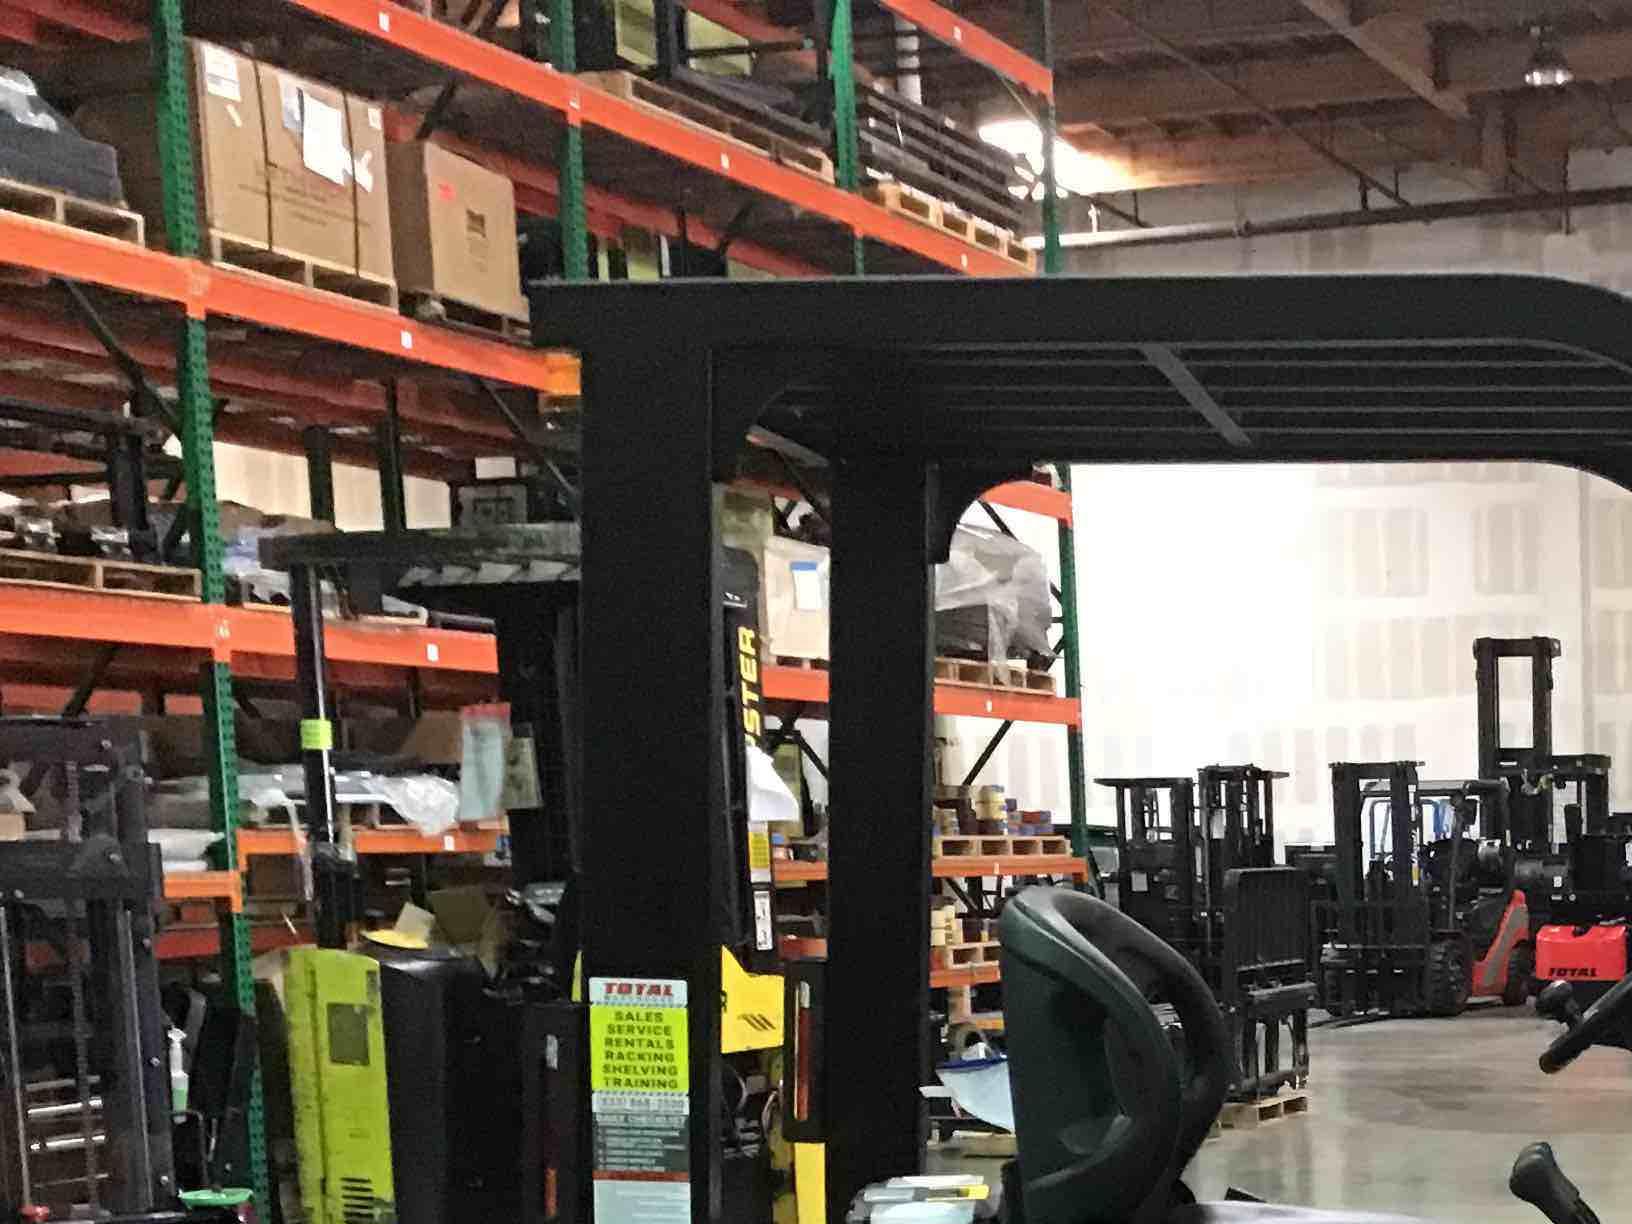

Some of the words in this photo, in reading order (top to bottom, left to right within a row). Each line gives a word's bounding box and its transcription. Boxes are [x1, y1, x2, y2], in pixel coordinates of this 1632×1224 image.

[1548, 967, 1597, 977] TOTAL
[603, 982, 674, 997] TOTAL
[614, 1011, 664, 1023] SALES
[607, 1024, 673, 1036] SERVICE
[604, 1037, 675, 1050] RENTALS
[604, 1050, 675, 1063] RACKING
[602, 1063, 679, 1076] SHELVING
[603, 1076, 679, 1090] TRAINING
